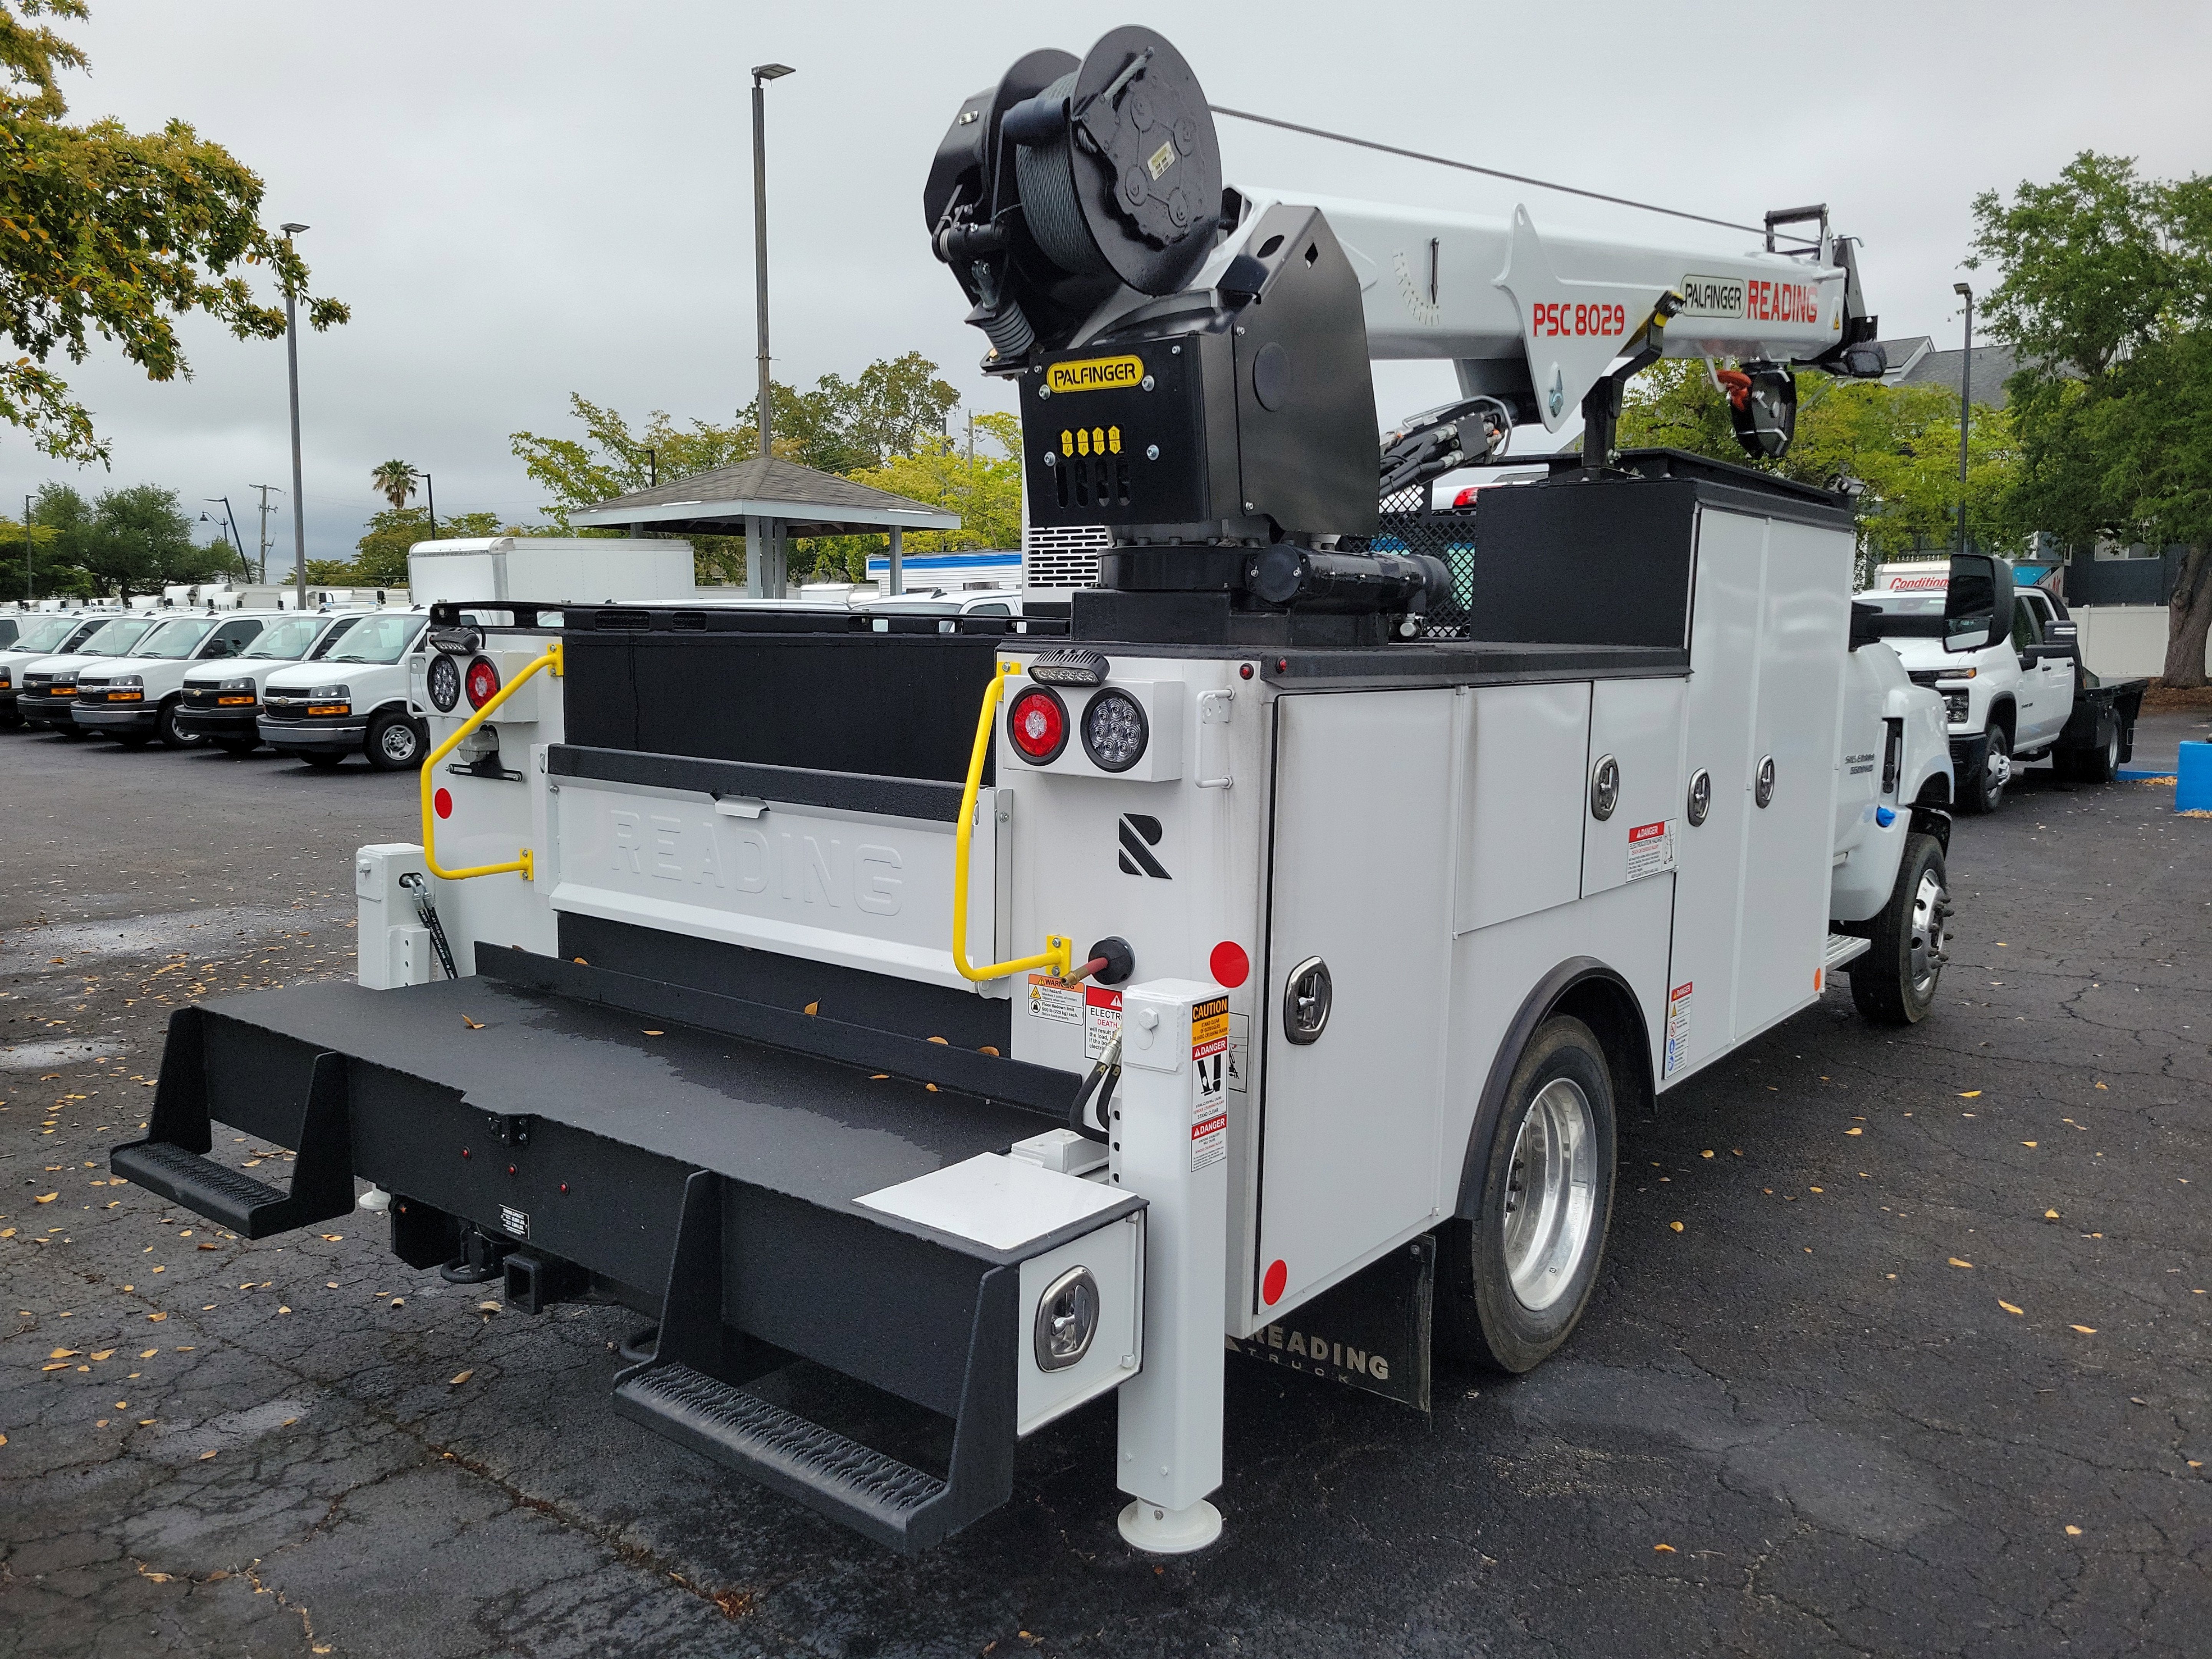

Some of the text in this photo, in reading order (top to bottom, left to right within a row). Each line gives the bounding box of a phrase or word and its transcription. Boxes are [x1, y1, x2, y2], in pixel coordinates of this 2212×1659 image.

[1685, 283, 1742, 311] PALFINGER
[1747, 280, 1818, 323] READING
[1533, 303, 1625, 337] PSC 8029
[1054, 363, 1136, 388] PALFINGER
[610, 810, 903, 917] READING
[1090, 1007, 1122, 1021] ELECTR
[1193, 998, 1227, 1020] CAUTION
[1201, 1040, 1226, 1055] DANGER
[1200, 1118, 1225, 1132] DANGER
